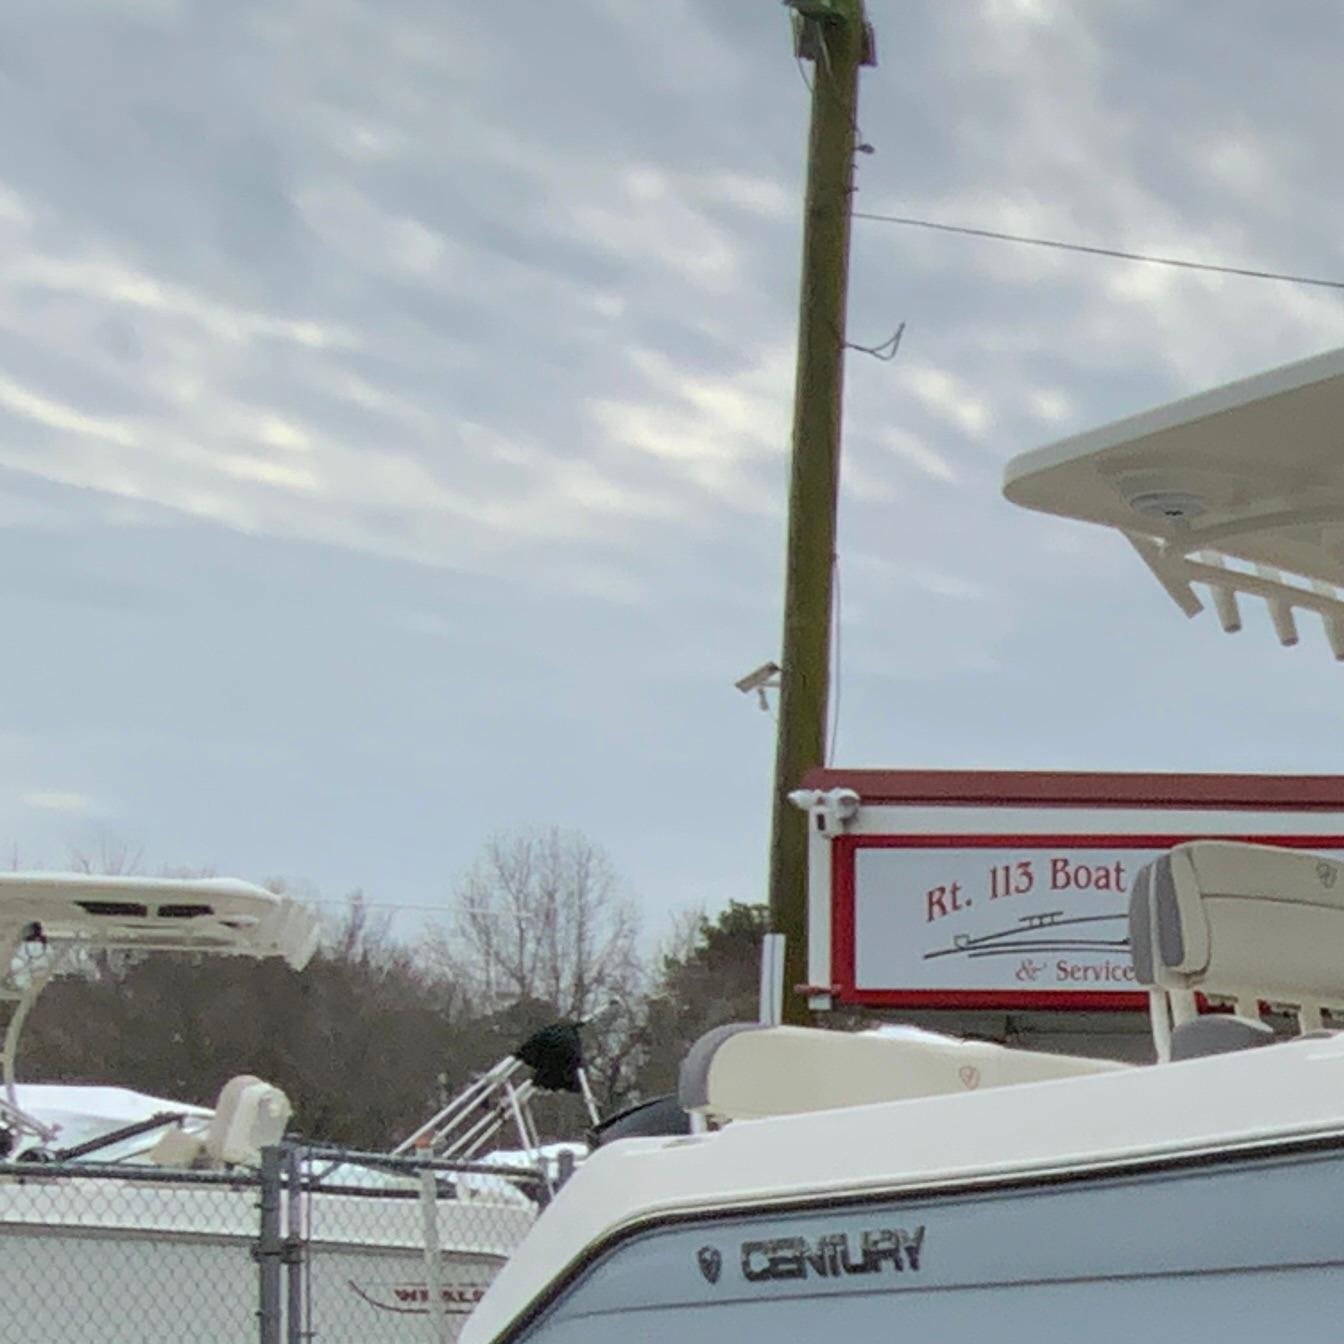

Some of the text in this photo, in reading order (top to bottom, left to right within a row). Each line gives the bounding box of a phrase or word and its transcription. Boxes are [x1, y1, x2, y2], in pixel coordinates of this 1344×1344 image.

[926, 858, 1127, 923] Rt. 113 Boat
[1056, 959, 1136, 983] Service
[741, 1225, 926, 1282] CENTURY
